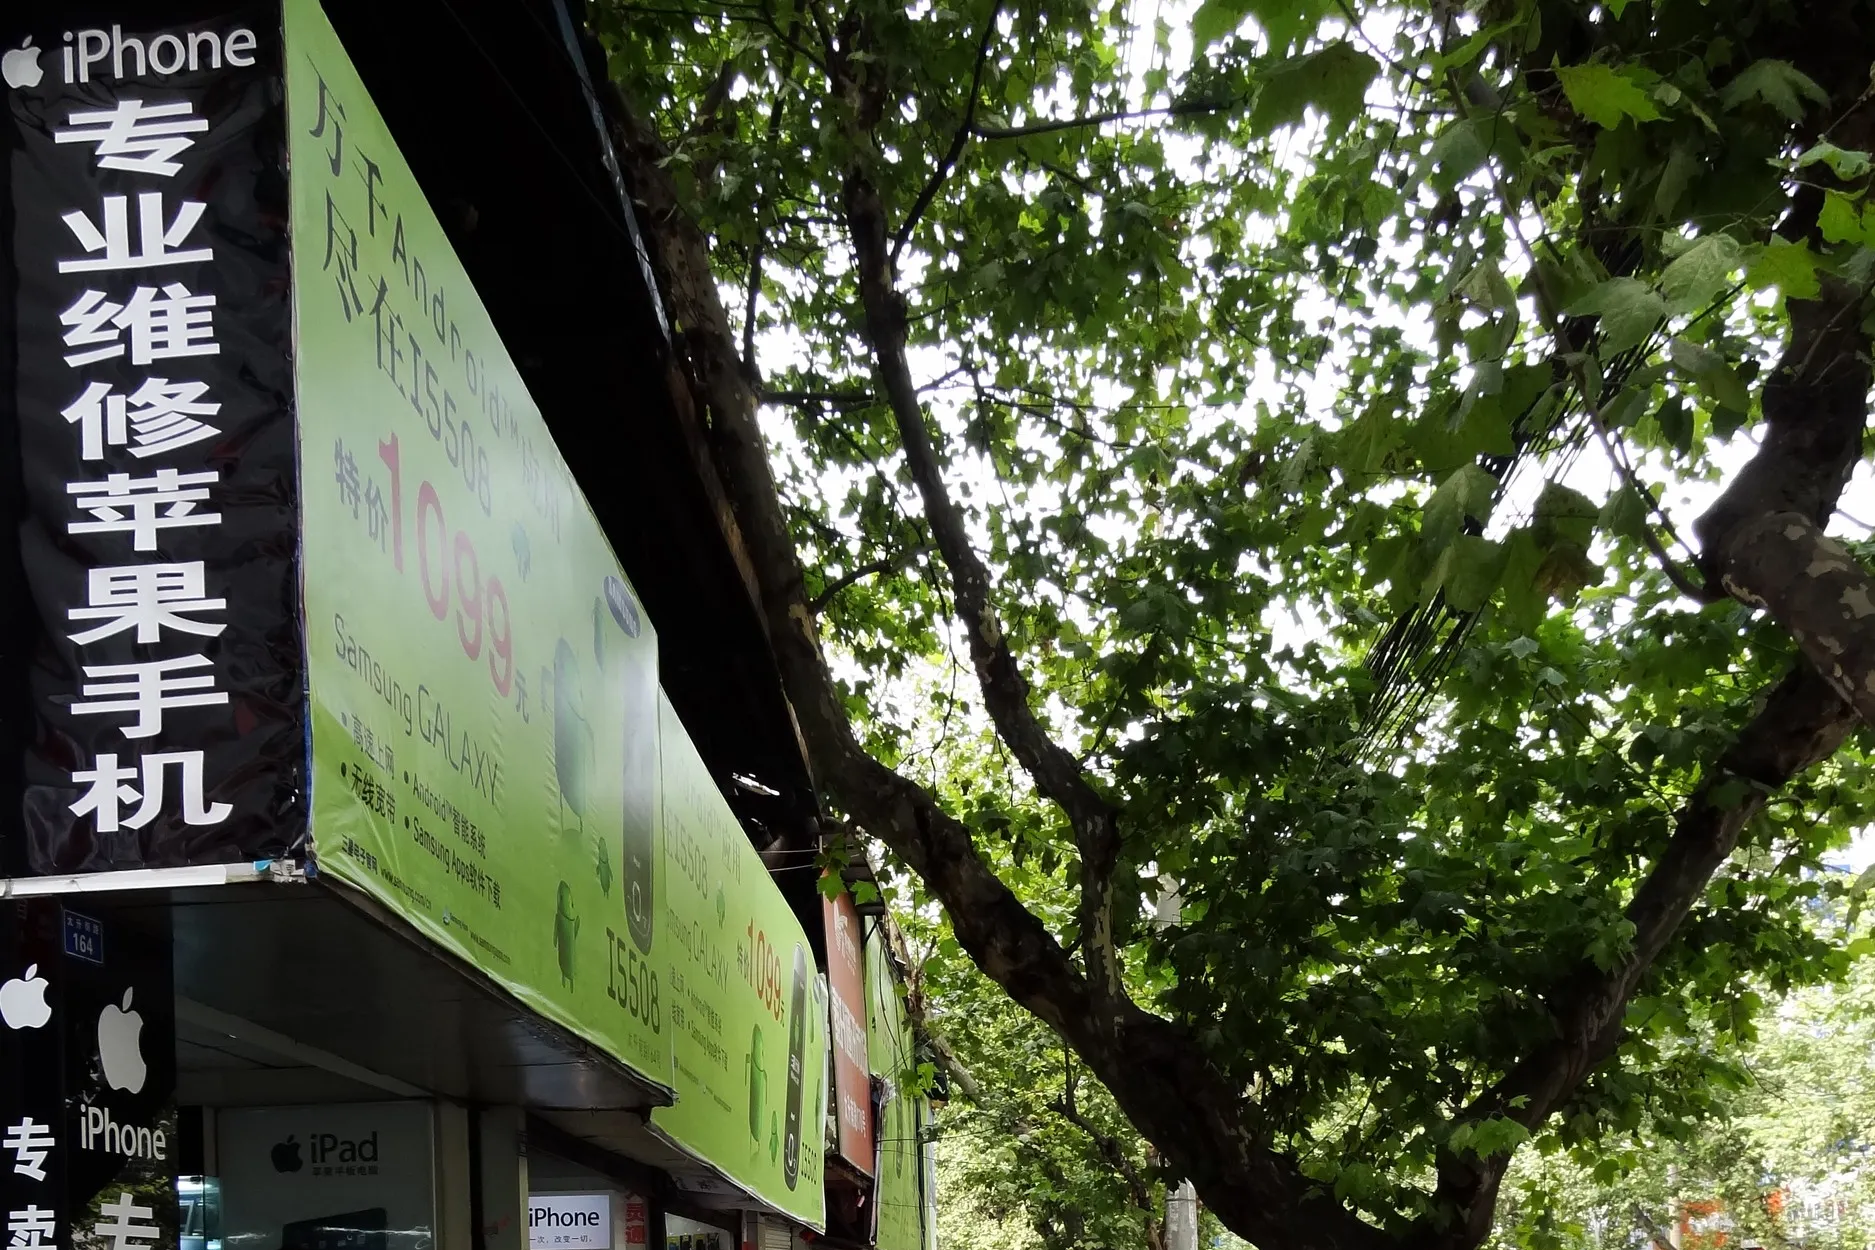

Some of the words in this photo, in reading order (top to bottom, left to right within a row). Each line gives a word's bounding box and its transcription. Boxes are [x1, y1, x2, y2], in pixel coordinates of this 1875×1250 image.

[63, 25, 257, 84] iPhone
[55, 99, 233, 833] 专业维修苹果手机
[334, 613, 412, 737] Samsung
[418, 684, 498, 806] GALAXY
[350, 714, 395, 781] 高速上网
[350, 763, 396, 825] 无线宽带
[412, 816, 450, 874] Samsung
[72, 932, 94, 955] 164
[693, 920, 730, 995] GALAXY
[605, 926, 661, 1036] I5508
[80, 1103, 167, 1161] iPhone
[310, 1131, 379, 1163] iPad
[529, 1207, 600, 1228] iPhone
